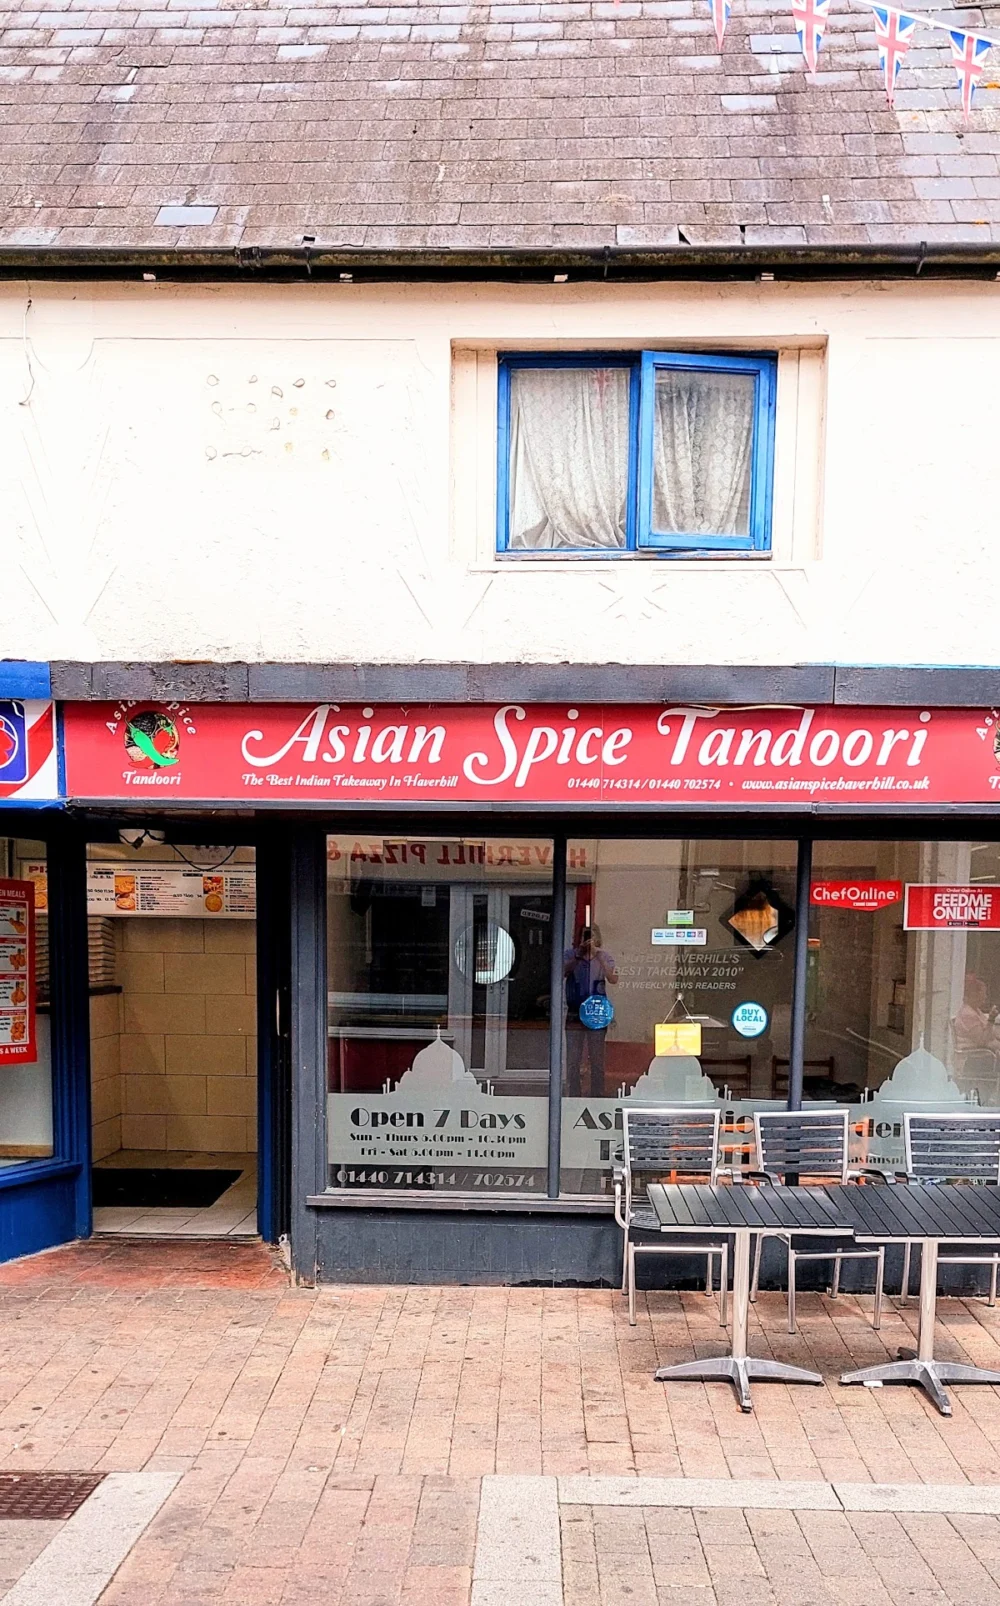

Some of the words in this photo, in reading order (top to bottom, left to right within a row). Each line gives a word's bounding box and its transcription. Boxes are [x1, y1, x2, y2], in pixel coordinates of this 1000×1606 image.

[105, 700, 146, 735] Asia
[159, 700, 197, 736] pice
[241, 703, 447, 767] Asian
[462, 704, 633, 788] Spice
[657, 706, 932, 767] Tandoori
[122, 769, 182, 786] Tandoori
[242, 773, 263, 786] The
[265, 774, 294, 787] Best
[295, 774, 331, 787] Indian
[332, 774, 388, 790] Takeaway
[389, 775, 401, 787] In
[403, 773, 459, 787] Haverhill
[567, 777, 601, 789] 01440
[683, 779, 721, 790] 702574
[741, 776, 930, 795] www.asianspicehaverhill.co.uk
[7, 889, 26, 898] MEALS
[812, 887, 896, 901] ChefOnline
[933, 893, 993, 907] FEEDME
[932, 906, 987, 920] ONLINE
[612, 966, 643, 976] BEST
[646, 966, 712, 977] TAKEAWAY
[668, 982, 693, 990] NEWS
[695, 982, 737, 990] READERS
[736, 1015, 764, 1023] LOCAL
[741, 1008, 760, 1016] BUY
[350, 1107, 425, 1128] Open
[432, 1109, 451, 1128] 7
[460, 1109, 526, 1130] Days
[349, 1132, 373, 1142] Sun
[384, 1132, 419, 1143] Thurs
[421, 1133, 465, 1144] 5.00pm
[477, 1135, 527, 1145] 10.30pm
[360, 1147, 377, 1156] Fri
[389, 1147, 407, 1157] Sat
[410, 1148, 454, 1158] 5.00pm
[336, 1169, 389, 1184] 01440
[392, 1171, 456, 1185] 714314
[472, 1173, 535, 1187] 702574
